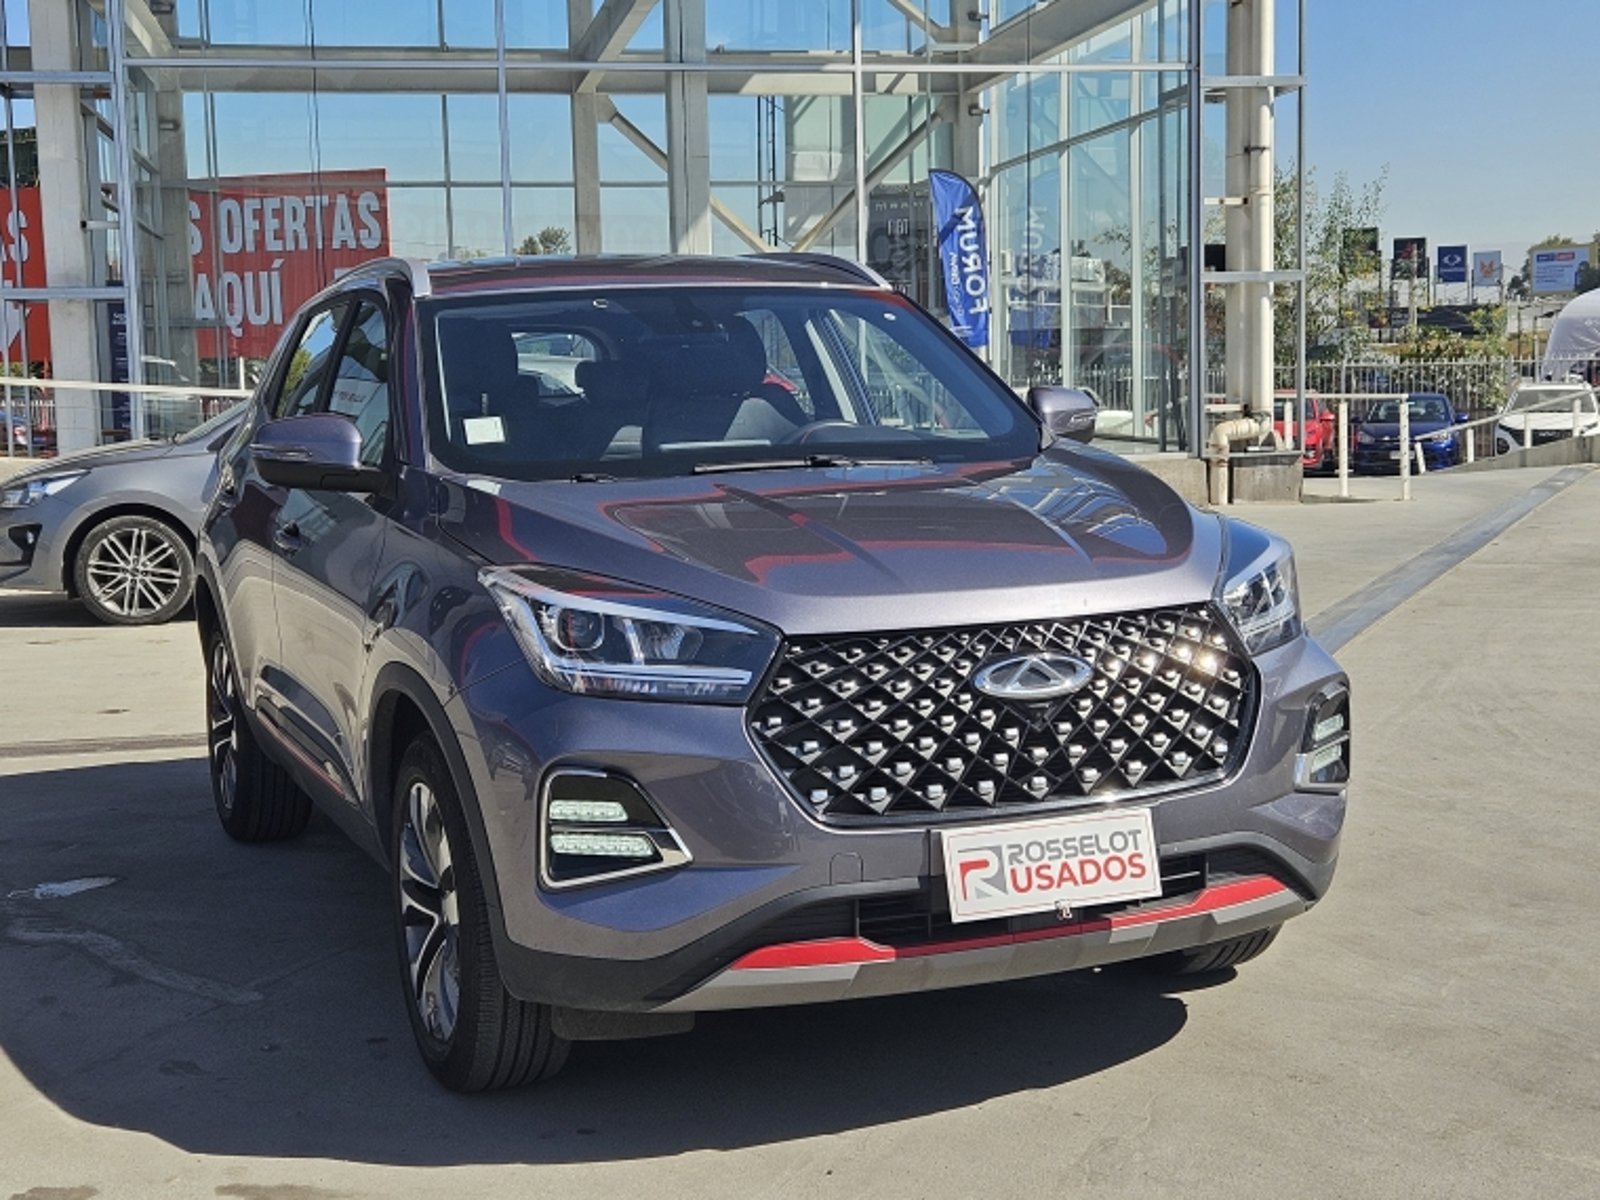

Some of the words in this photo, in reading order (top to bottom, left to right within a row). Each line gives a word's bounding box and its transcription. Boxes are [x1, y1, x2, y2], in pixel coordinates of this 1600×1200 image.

[218, 192, 382, 253] OFERTAS
[195, 259, 284, 337] AQUÍ
[1006, 829, 1142, 866] ROSSELOT
[1010, 853, 1146, 893] USADOS
